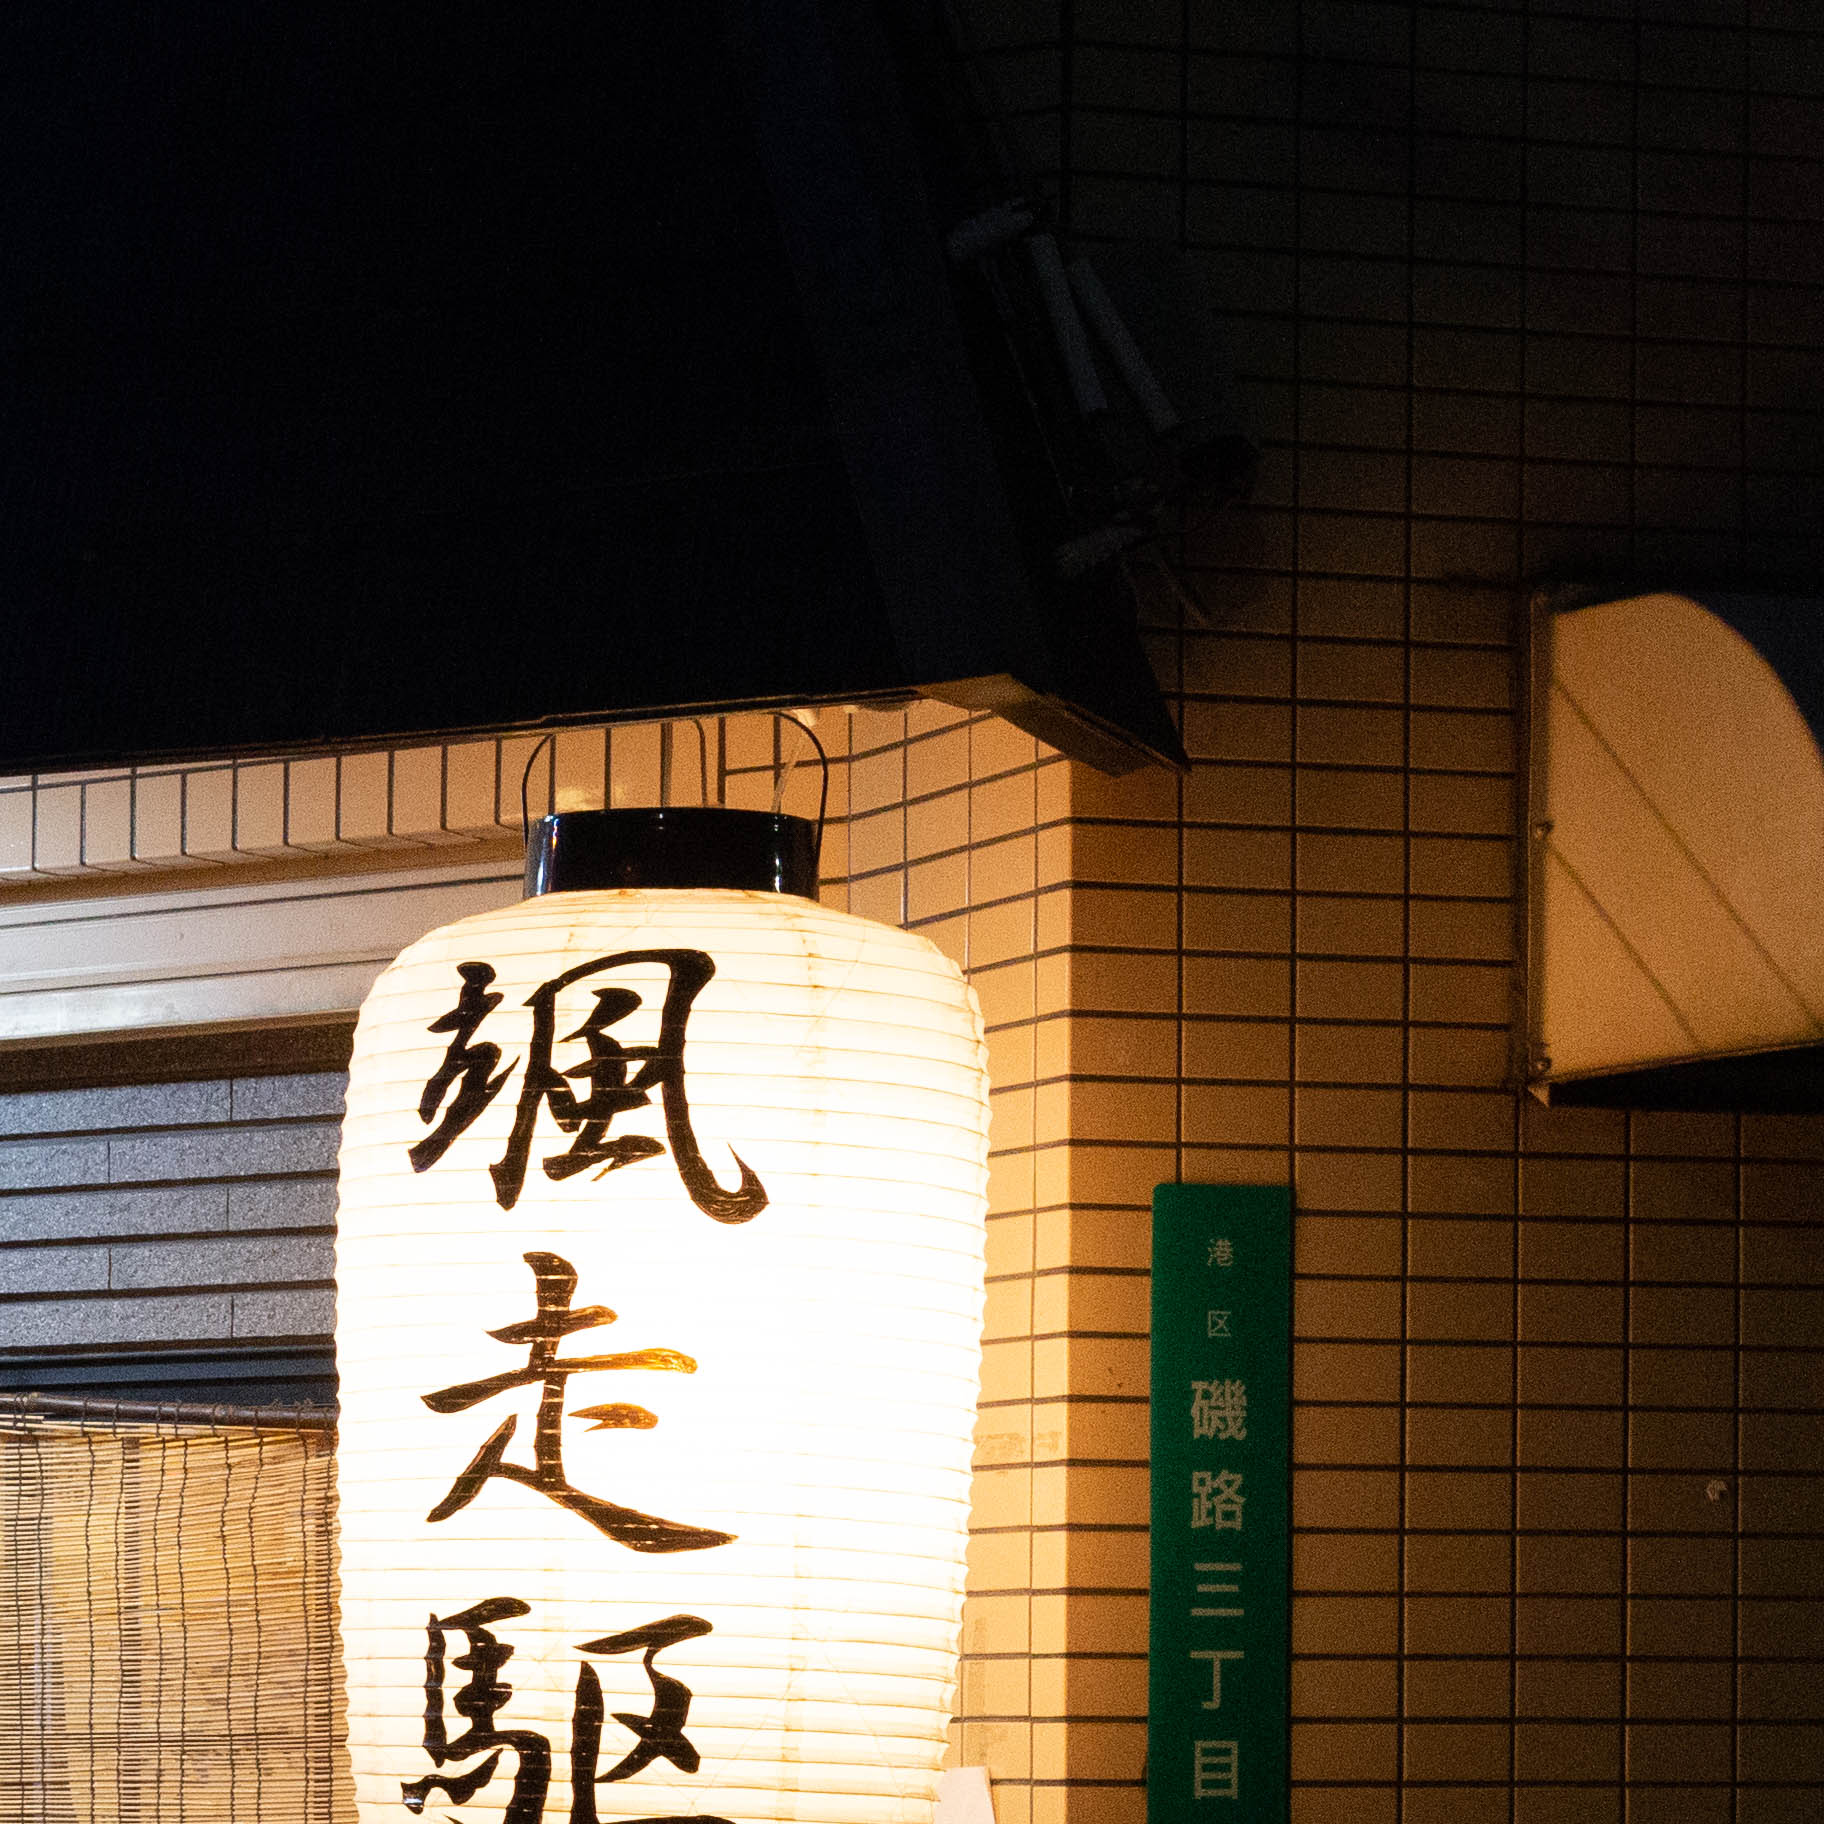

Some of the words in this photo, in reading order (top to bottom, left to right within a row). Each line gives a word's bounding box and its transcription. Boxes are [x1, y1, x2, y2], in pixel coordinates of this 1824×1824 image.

[1207, 1238, 1235, 1339] 港区
[1190, 1378, 1249, 1801] 磯路三丁目
